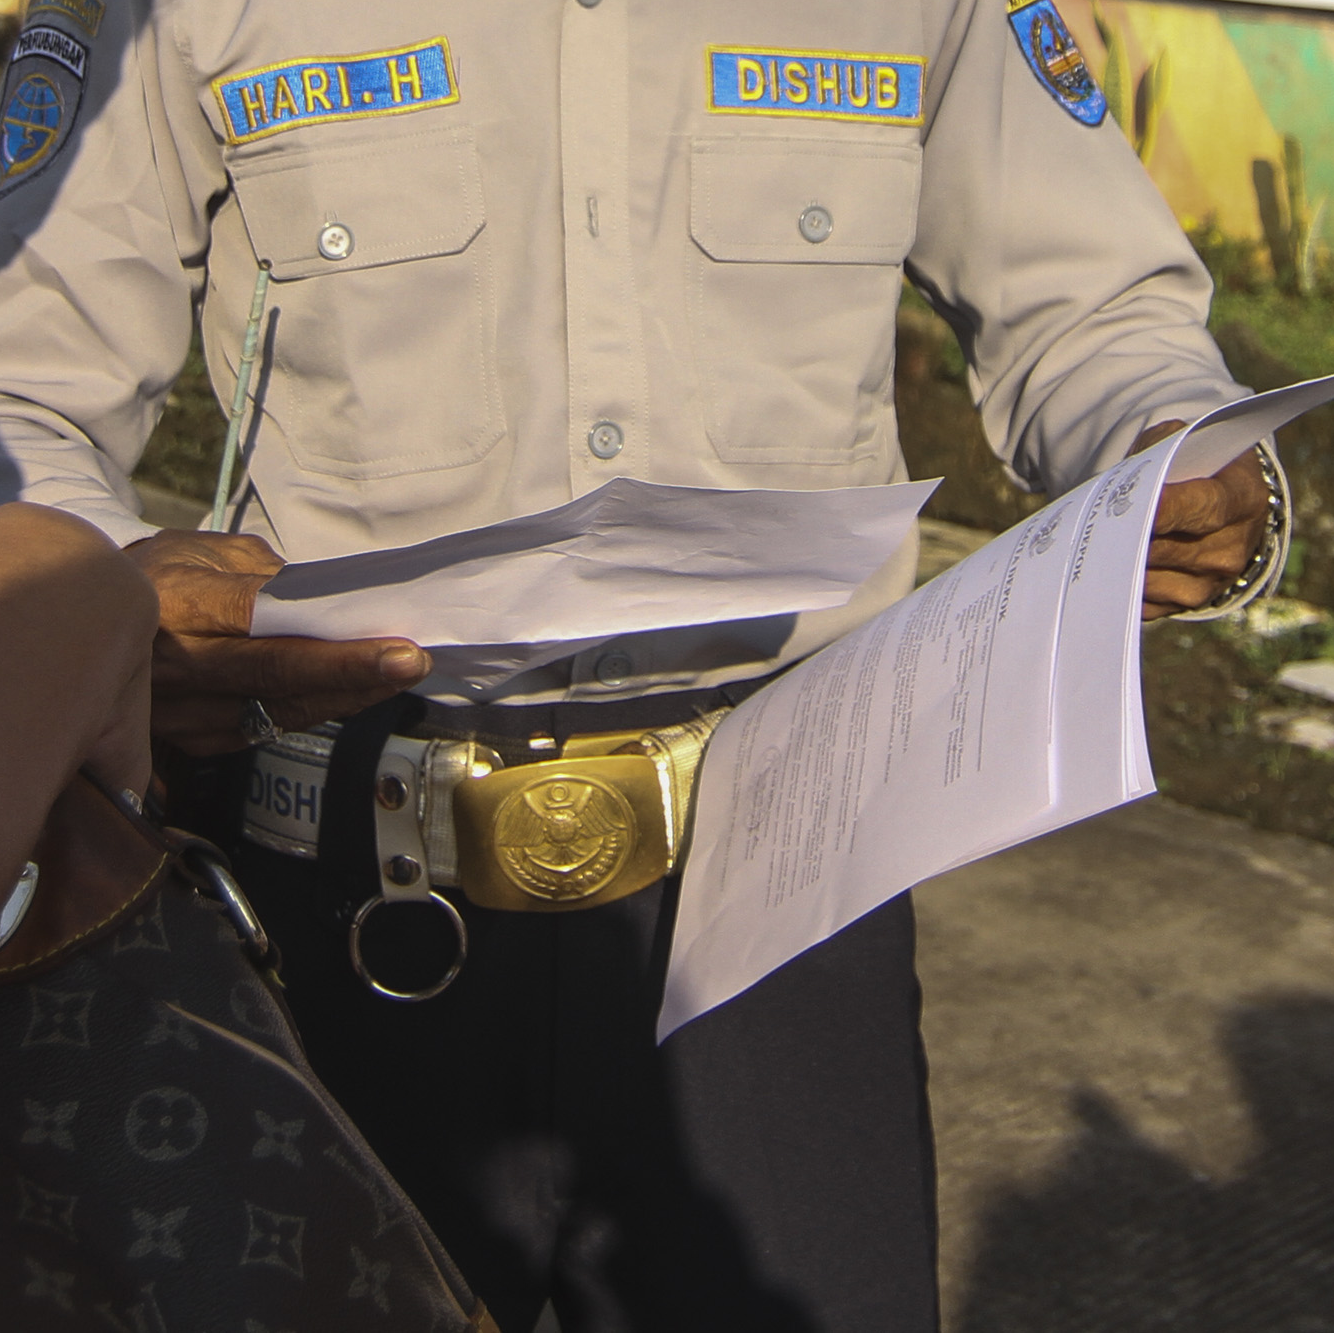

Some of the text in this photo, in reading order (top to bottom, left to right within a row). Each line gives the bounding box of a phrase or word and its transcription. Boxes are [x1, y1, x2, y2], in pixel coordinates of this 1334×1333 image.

[387, 54, 423, 104] H
[736, 56, 900, 110] DISHUB
[1070, 522, 1095, 584] DEPOK
[998, 565, 1019, 624] DEPOK
[248, 767, 317, 825] DISH
